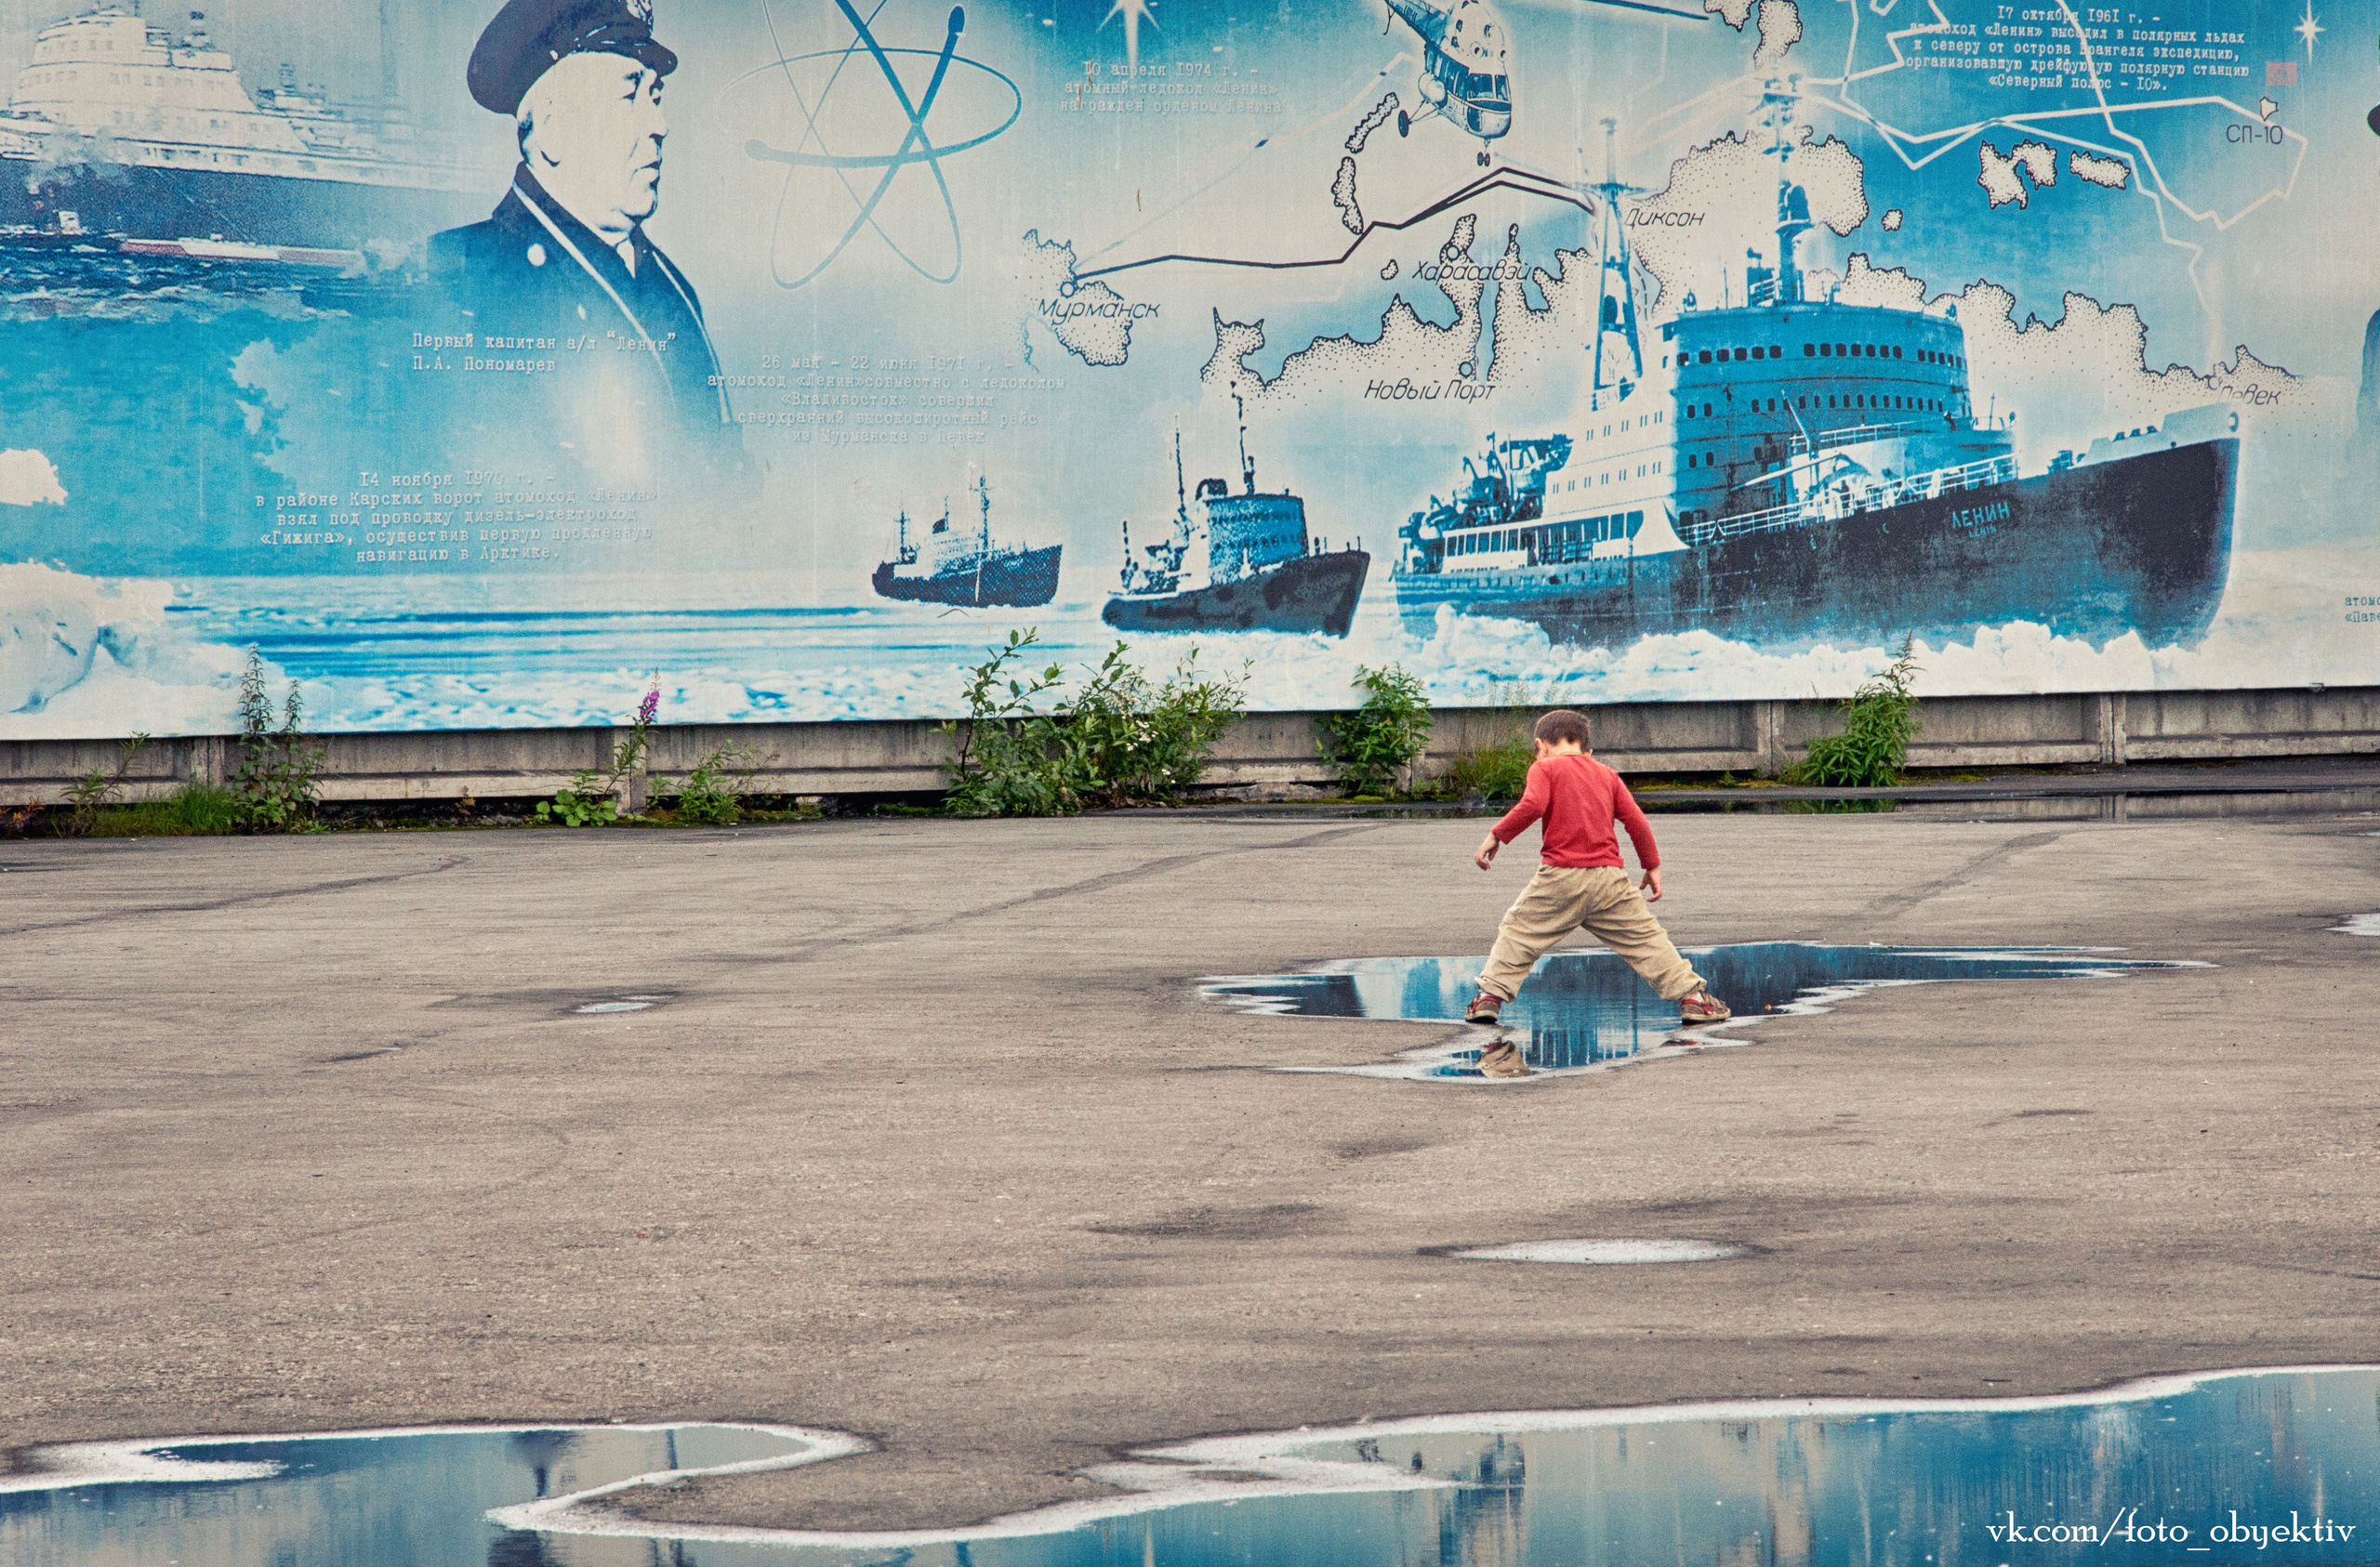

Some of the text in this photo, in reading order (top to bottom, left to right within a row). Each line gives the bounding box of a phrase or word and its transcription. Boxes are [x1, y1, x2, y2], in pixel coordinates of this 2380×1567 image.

[2022, 8, 2079, 24] октября
[2129, 13, 2143, 24] г.
[1985, 23, 2043, 38] «Ленин»
[2116, 29, 2124, 39] в
[2133, 30, 2197, 44] полярных
[2205, 32, 2245, 45] льдах
[1931, 40, 1980, 55] северу
[1989, 42, 2004, 53] от
[2014, 43, 2071, 57] острова
[2153, 46, 2240, 62] экспедицию,
[1111, 64, 1167, 79] апреля
[1906, 56, 2022, 72] организовавшую
[2121, 61, 2185, 77] полярную
[2193, 64, 2249, 78] станцию
[1212, 82, 1277, 95] «Ленин»
[1989, 73, 2062, 90] «Северный
[1061, 99, 1282, 114] награжден орденом Ленина
[2227, 125, 2283, 144] СП-10
[1624, 208, 1706, 230] Диксон
[1412, 259, 1531, 286] Харасавэй
[1038, 299, 1161, 325] Мурманск
[413, 332, 474, 350] Первый
[485, 336, 556, 349] капитан
[567, 335, 597, 353] а/л
[413, 355, 556, 374] П.А. Пономарев
[762, 355, 781, 369] 26
[791, 356, 821, 369] мая
[851, 355, 869, 369] 22
[880, 358, 918, 370] июня
[707, 374, 787, 388] атомоход
[961, 377, 970, 388] с
[981, 376, 1065, 390] ледоколом
[1364, 377, 1497, 404] Новый Порт
[919, 394, 994, 409] совершил
[999, 411, 1038, 428] рейс
[793, 430, 811, 442] из
[821, 428, 908, 444] Мурманска
[392, 472, 453, 489] ноября
[256, 495, 265, 507] в
[276, 492, 338, 510] районе
[350, 493, 422, 508] Карских
[434, 492, 483, 507] ворот
[495, 491, 575, 505] атомоход
[276, 514, 318, 526] взял
[330, 513, 360, 526] под
[372, 511, 453, 528] проводку
[1952, 500, 2010, 529] ЛЕНИН
[366, 530, 469, 546] осуществив
[480, 528, 540, 544] первую
[552, 526, 652, 543] продленную
[357, 546, 559, 563] навигацию в Арктике.
